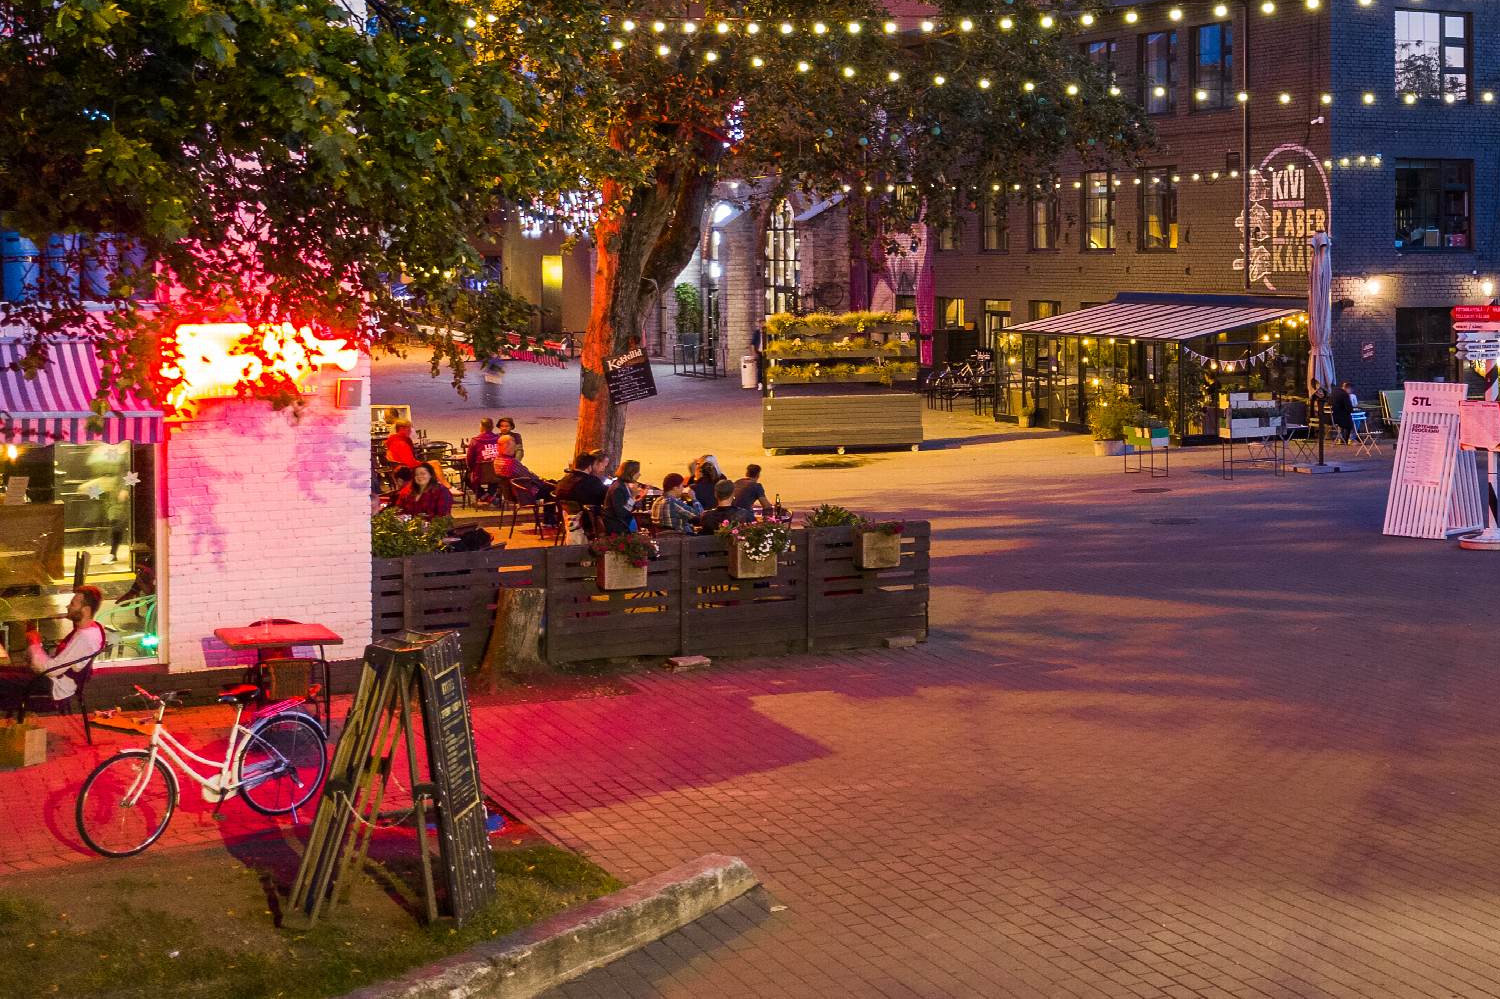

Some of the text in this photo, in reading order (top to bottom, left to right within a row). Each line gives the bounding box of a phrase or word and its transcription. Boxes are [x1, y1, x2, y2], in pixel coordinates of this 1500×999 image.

[1272, 169, 1305, 200] KIVI
[1272, 209, 1325, 237] PABER
[1411, 396, 1432, 407] STL
